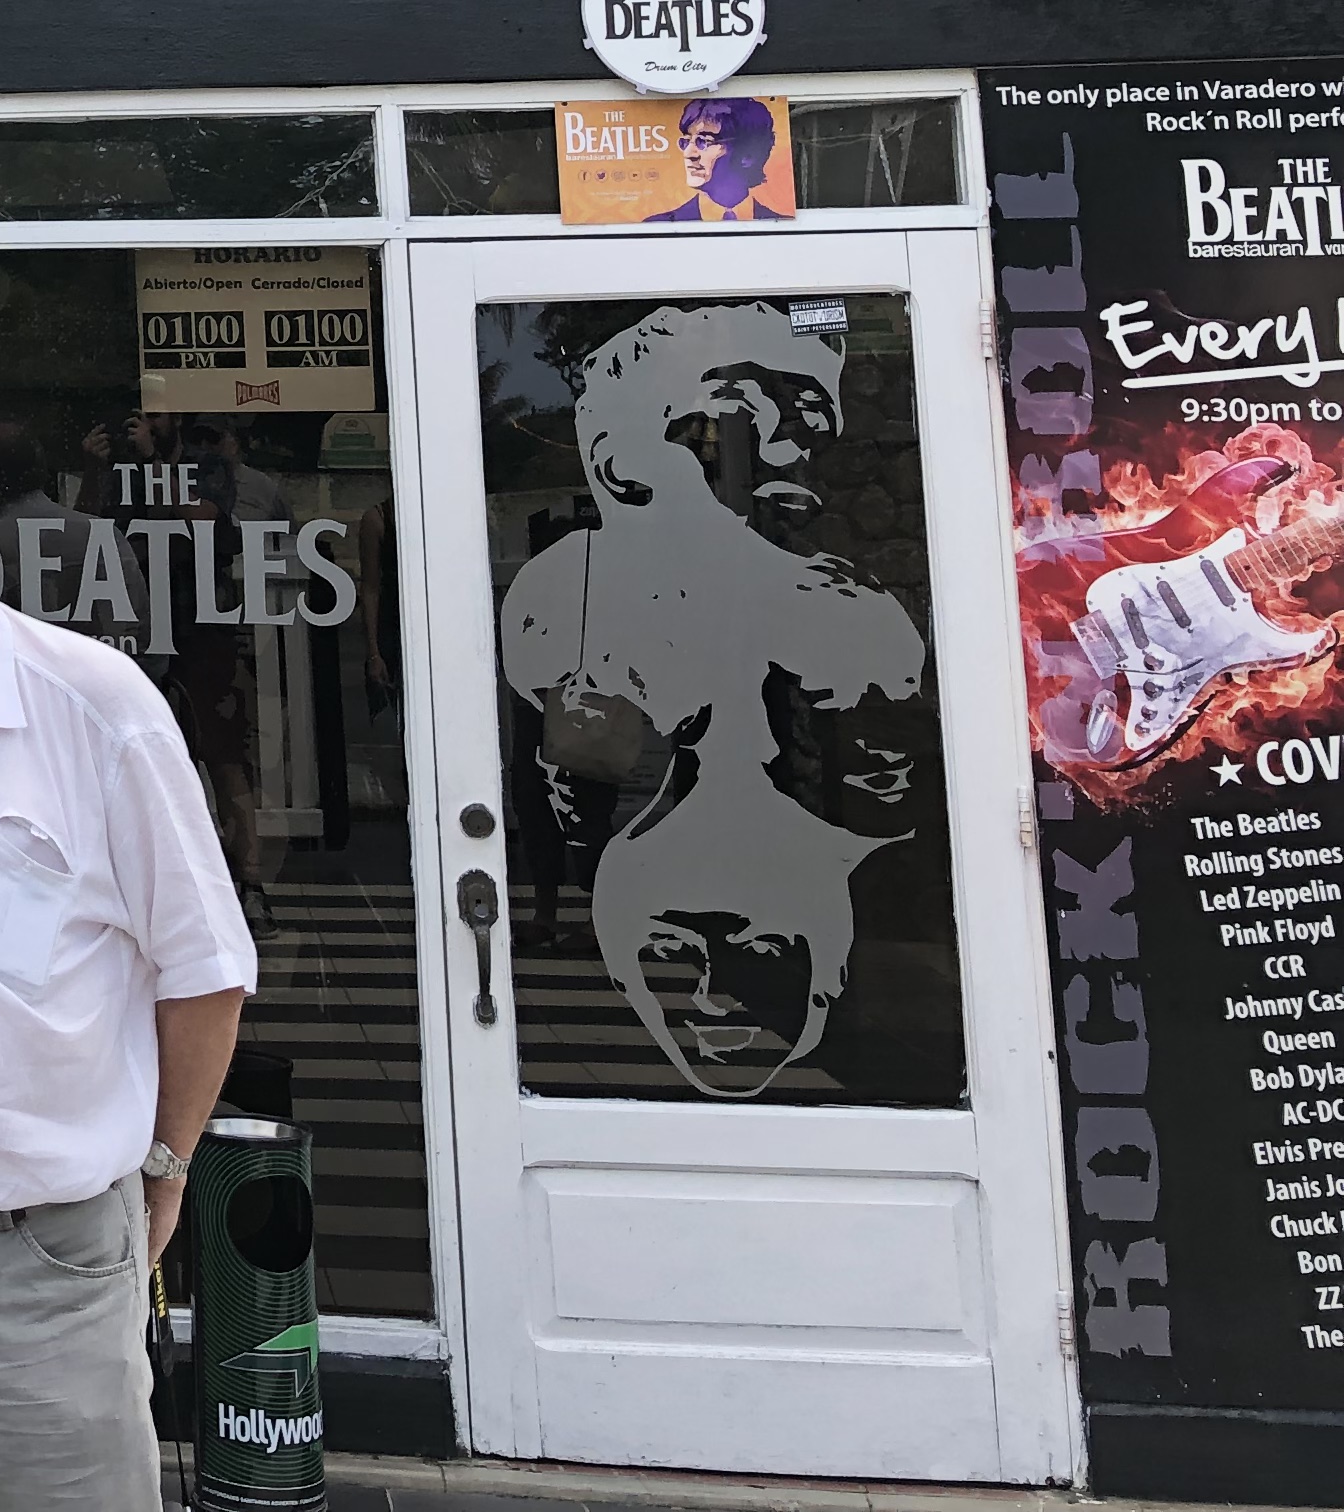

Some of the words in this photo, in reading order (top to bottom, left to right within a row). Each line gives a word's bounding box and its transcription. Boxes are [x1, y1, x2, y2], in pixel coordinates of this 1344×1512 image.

[644, 61, 677, 72] Drum
[682, 60, 708, 73] City
[996, 86, 1041, 106] The
[1047, 84, 1099, 108] only
[1105, 82, 1170, 107] place
[1176, 81, 1199, 101] in
[1202, 78, 1315, 101] Varadero
[603, 110, 625, 123] THE
[1236, 107, 1283, 129] Roll
[564, 112, 669, 160] BEATLES
[1277, 157, 1332, 184] THE
[193, 246, 322, 264] HORARIO
[1188, 241, 1304, 258] barestauran
[142, 276, 243, 291] Abierto/Open
[250, 275, 364, 291] Cerrado/Closed
[146, 315, 184, 346] 01
[197, 315, 240, 346] 00
[269, 314, 308, 345] 01
[320, 313, 364, 345] 00
[994, 131, 1106, 562] ROLL
[1099, 299, 1322, 388] Every
[179, 352, 217, 369] PM
[299, 351, 339, 368] AM
[1180, 397, 1301, 427] 9:30pm
[1308, 398, 1343, 421] to
[113, 462, 201, 506] THE
[1256, 735, 1344, 786] COV
[1190, 816, 1233, 840] The
[1237, 808, 1322, 837] Beatles
[1184, 850, 1264, 877] Rolling
[1266, 846, 1344, 871] Stones
[1200, 886, 1241, 912] Led
[1243, 879, 1342, 912] Zeppelin
[1220, 921, 1272, 947] Pink
[1273, 914, 1336, 946] Floyd
[1264, 954, 1307, 979] CCR
[1224, 994, 1303, 1021] Johnny
[1263, 1030, 1336, 1055] Queen
[1249, 1066, 1295, 1092] Bob
[1052, 835, 1173, 1357] ROCK
[1282, 1098, 1344, 1126] AC-DC
[1252, 1139, 1305, 1165] Elvis
[1265, 1175, 1322, 1202] Janis
[1270, 1211, 1338, 1238] Chuck
[1297, 1250, 1343, 1274] Bon
[1315, 1285, 1344, 1310] ZZ
[1301, 1325, 1344, 1349] The
